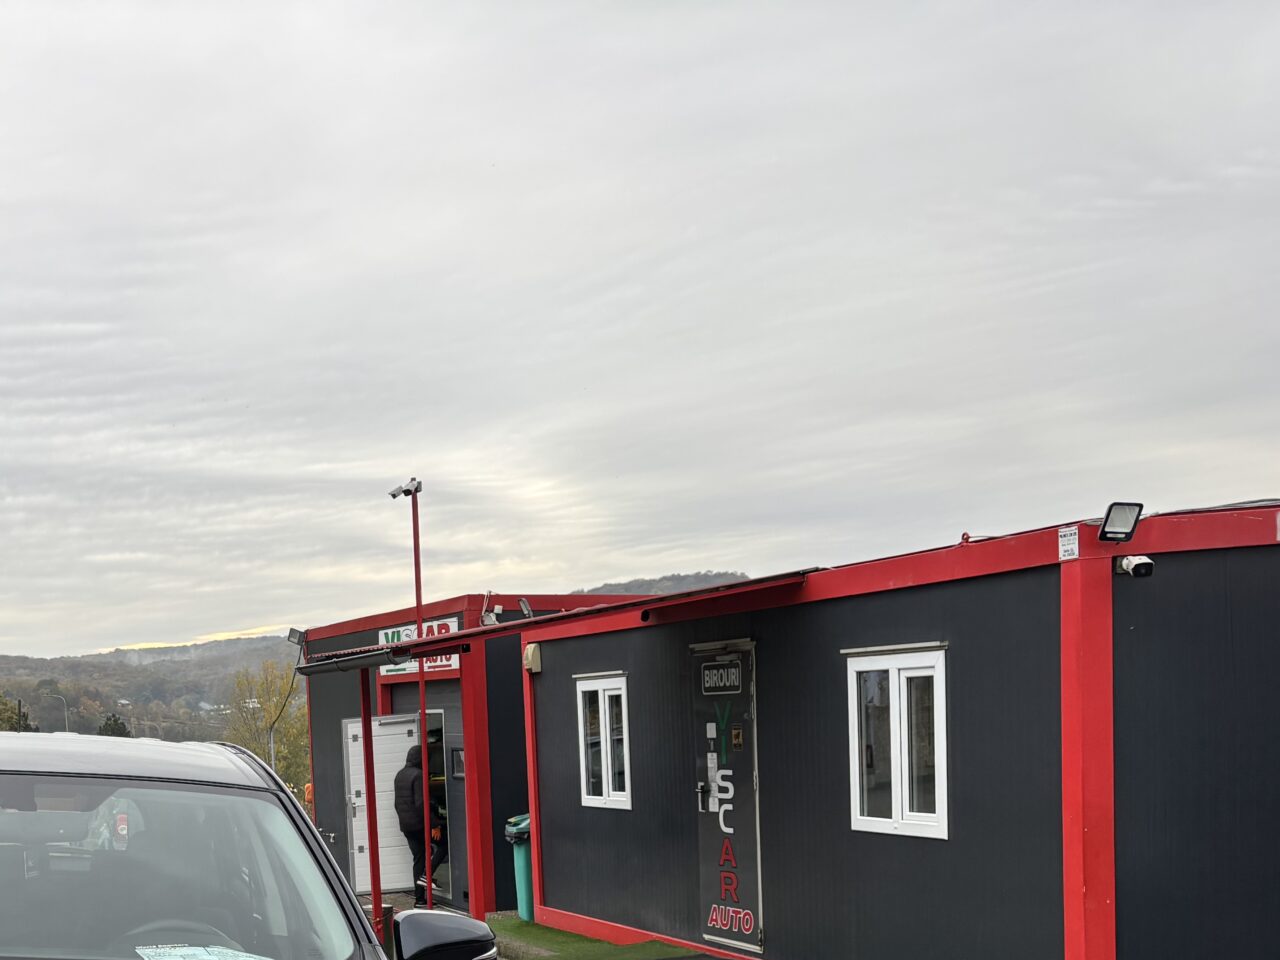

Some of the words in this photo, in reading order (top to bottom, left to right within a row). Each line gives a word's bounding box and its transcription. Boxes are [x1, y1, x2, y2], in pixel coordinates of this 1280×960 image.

[384, 623, 451, 644] VISAR
[704, 668, 739, 687] BIROURI
[707, 904, 754, 934] AUTO
